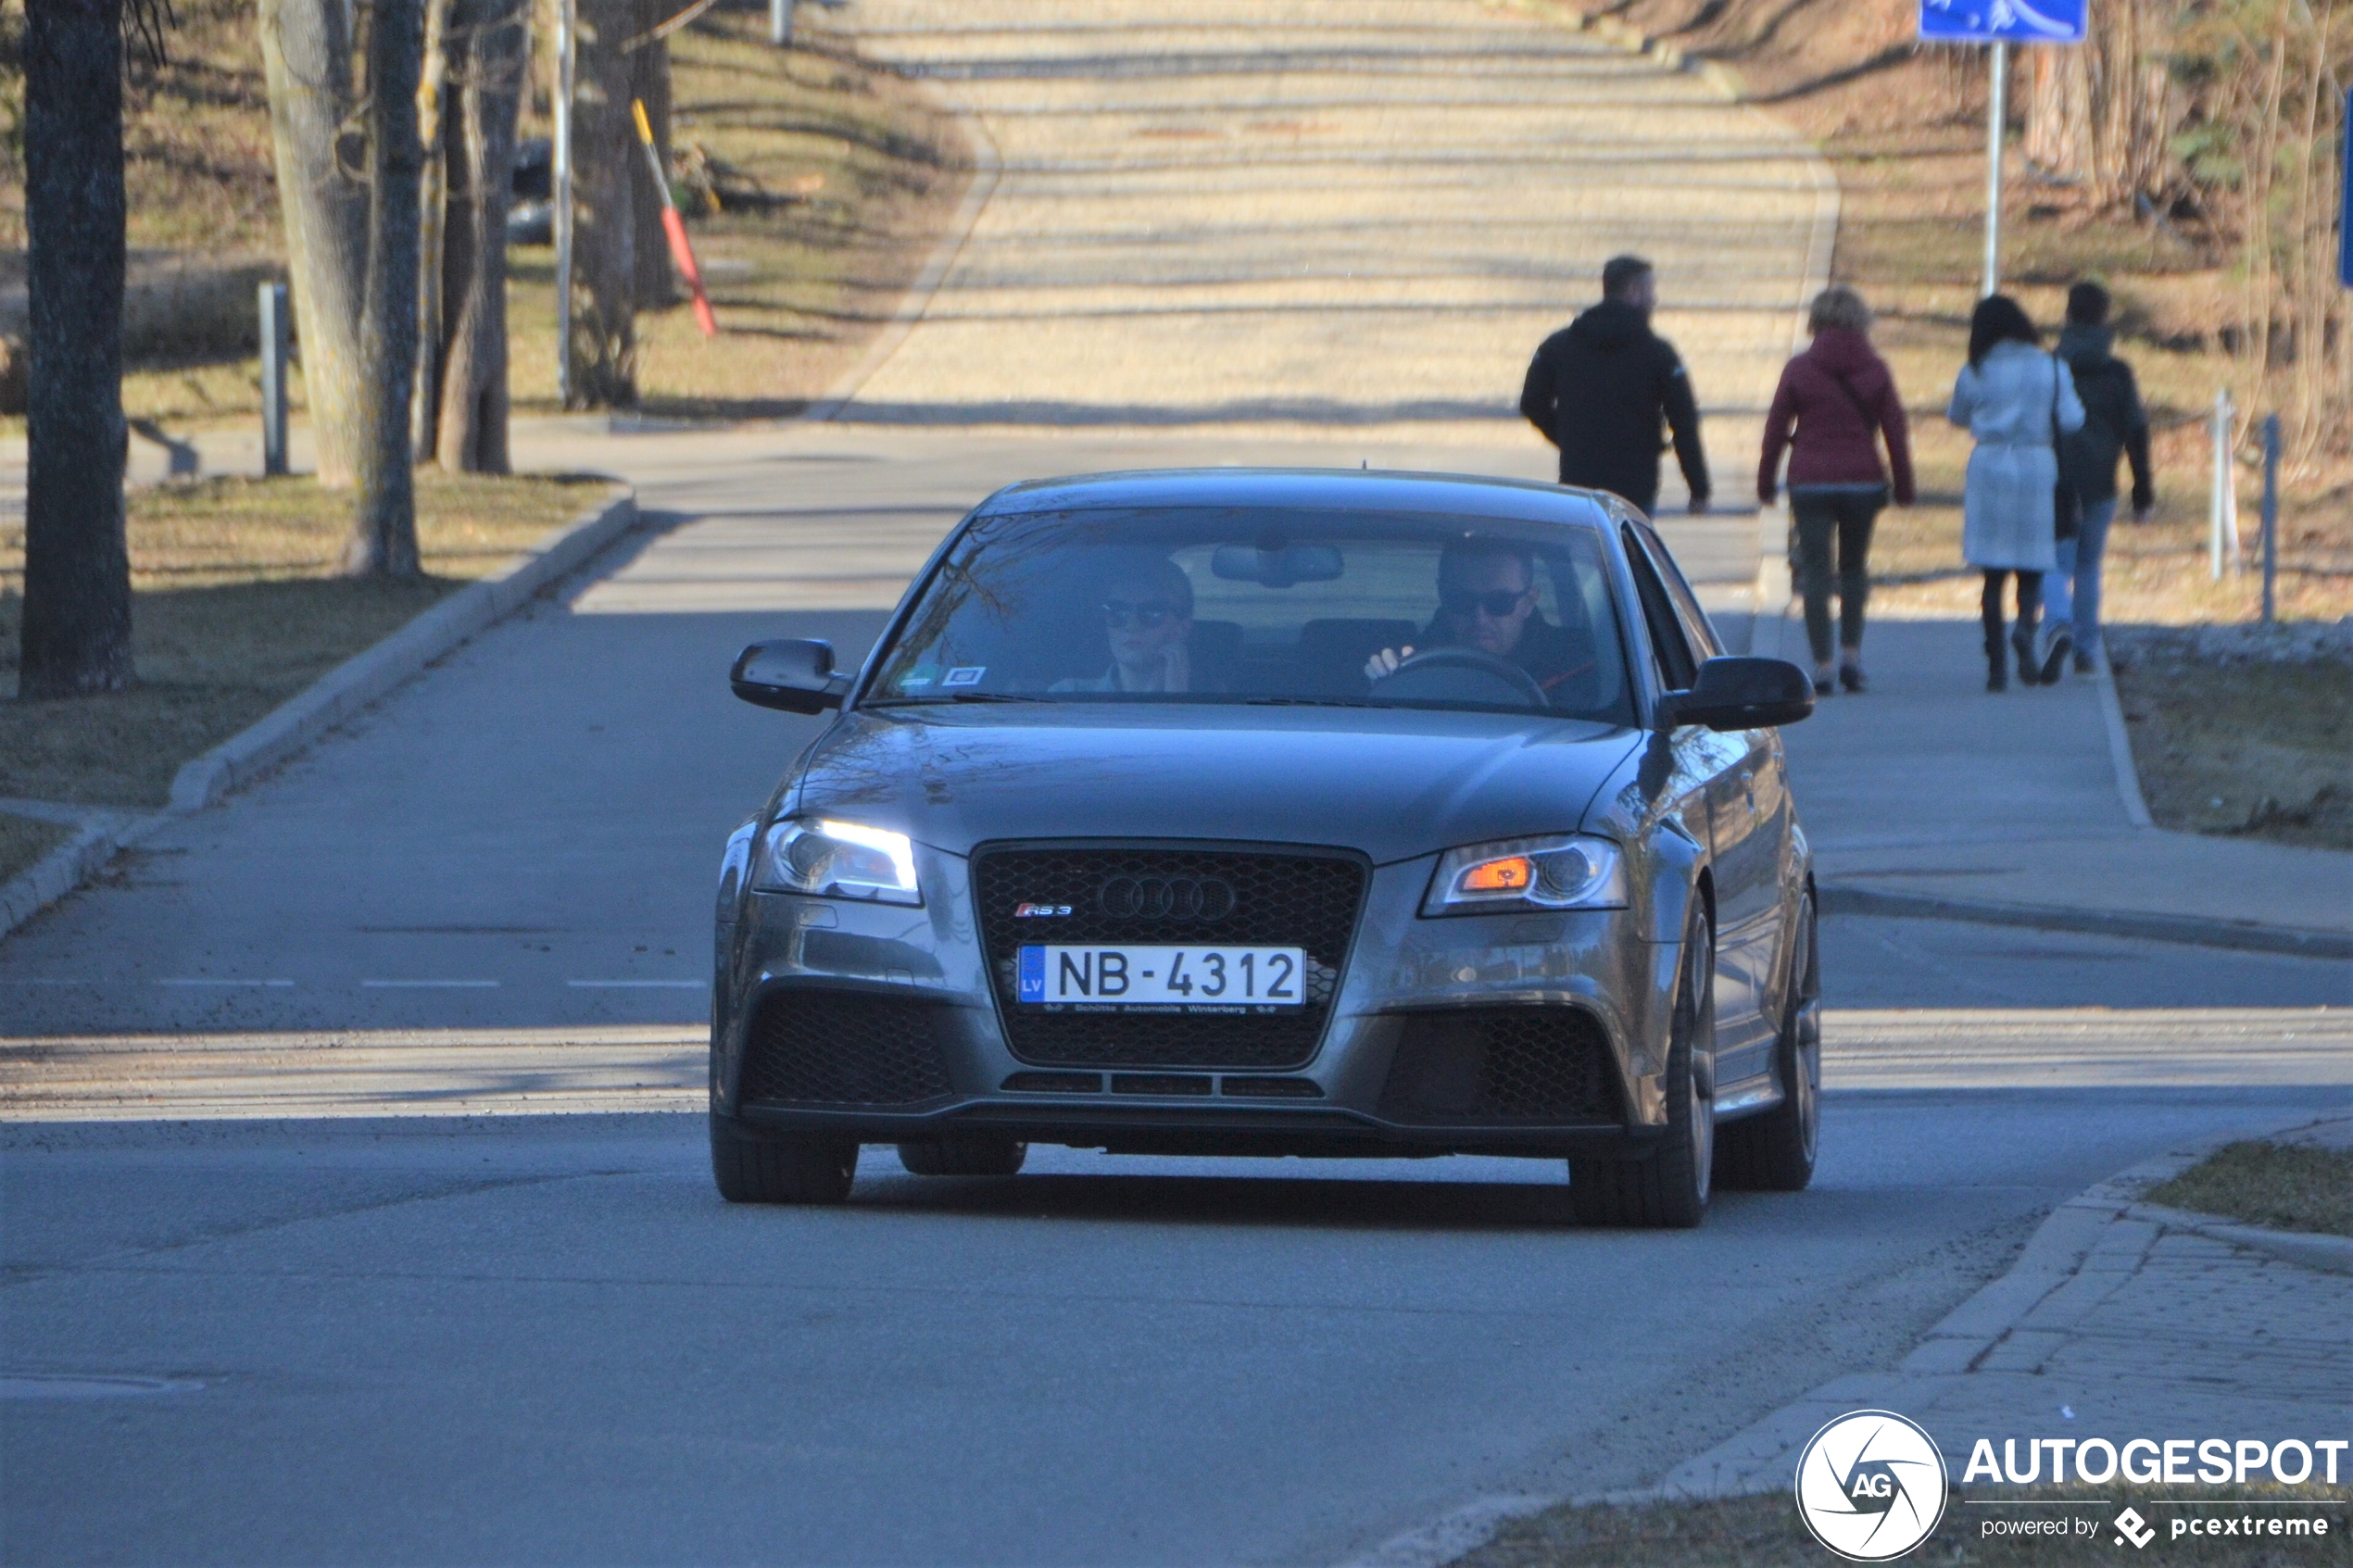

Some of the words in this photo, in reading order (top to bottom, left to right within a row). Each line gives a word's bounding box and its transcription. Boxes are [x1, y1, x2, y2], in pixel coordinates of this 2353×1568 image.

[1022, 905, 1054, 916] RS
[1057, 906, 1073, 916] 3
[1022, 980, 1042, 992] LV
[1059, 951, 1293, 997] NB-4312
[1188, 1005, 1247, 1014] Winterberg
